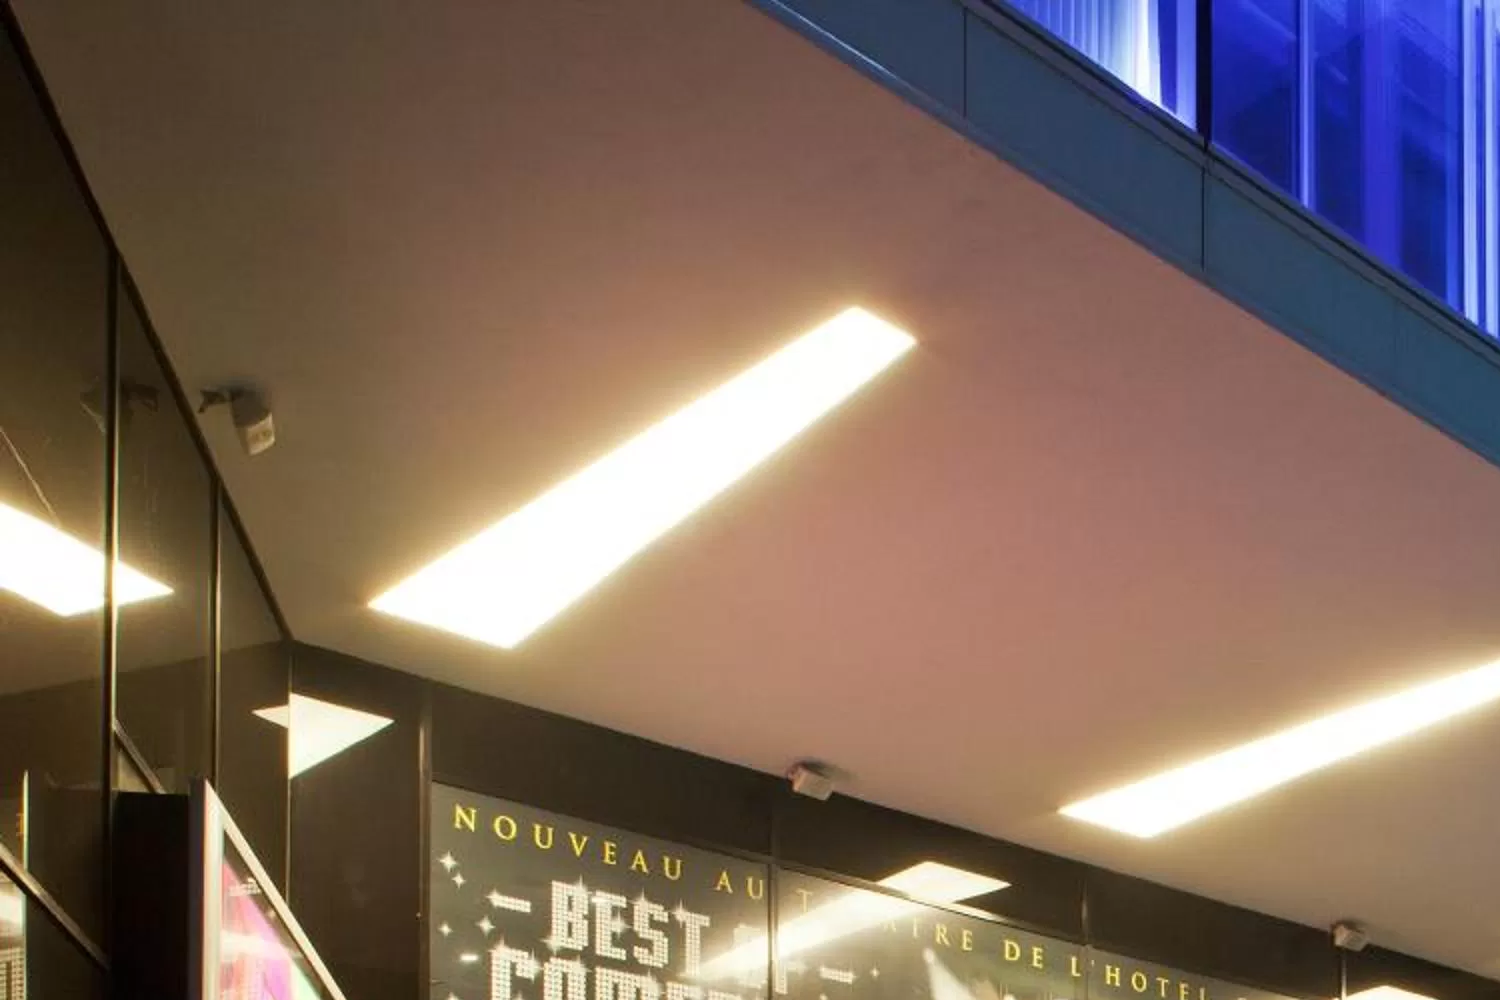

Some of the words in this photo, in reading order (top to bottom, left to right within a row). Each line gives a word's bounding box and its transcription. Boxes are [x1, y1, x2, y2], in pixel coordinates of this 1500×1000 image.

[454, 803, 682, 880] NOUVEAU
[714, 870, 763, 900] AU
[1004, 940, 1044, 969] DE
[551, 879, 711, 977] BEST
